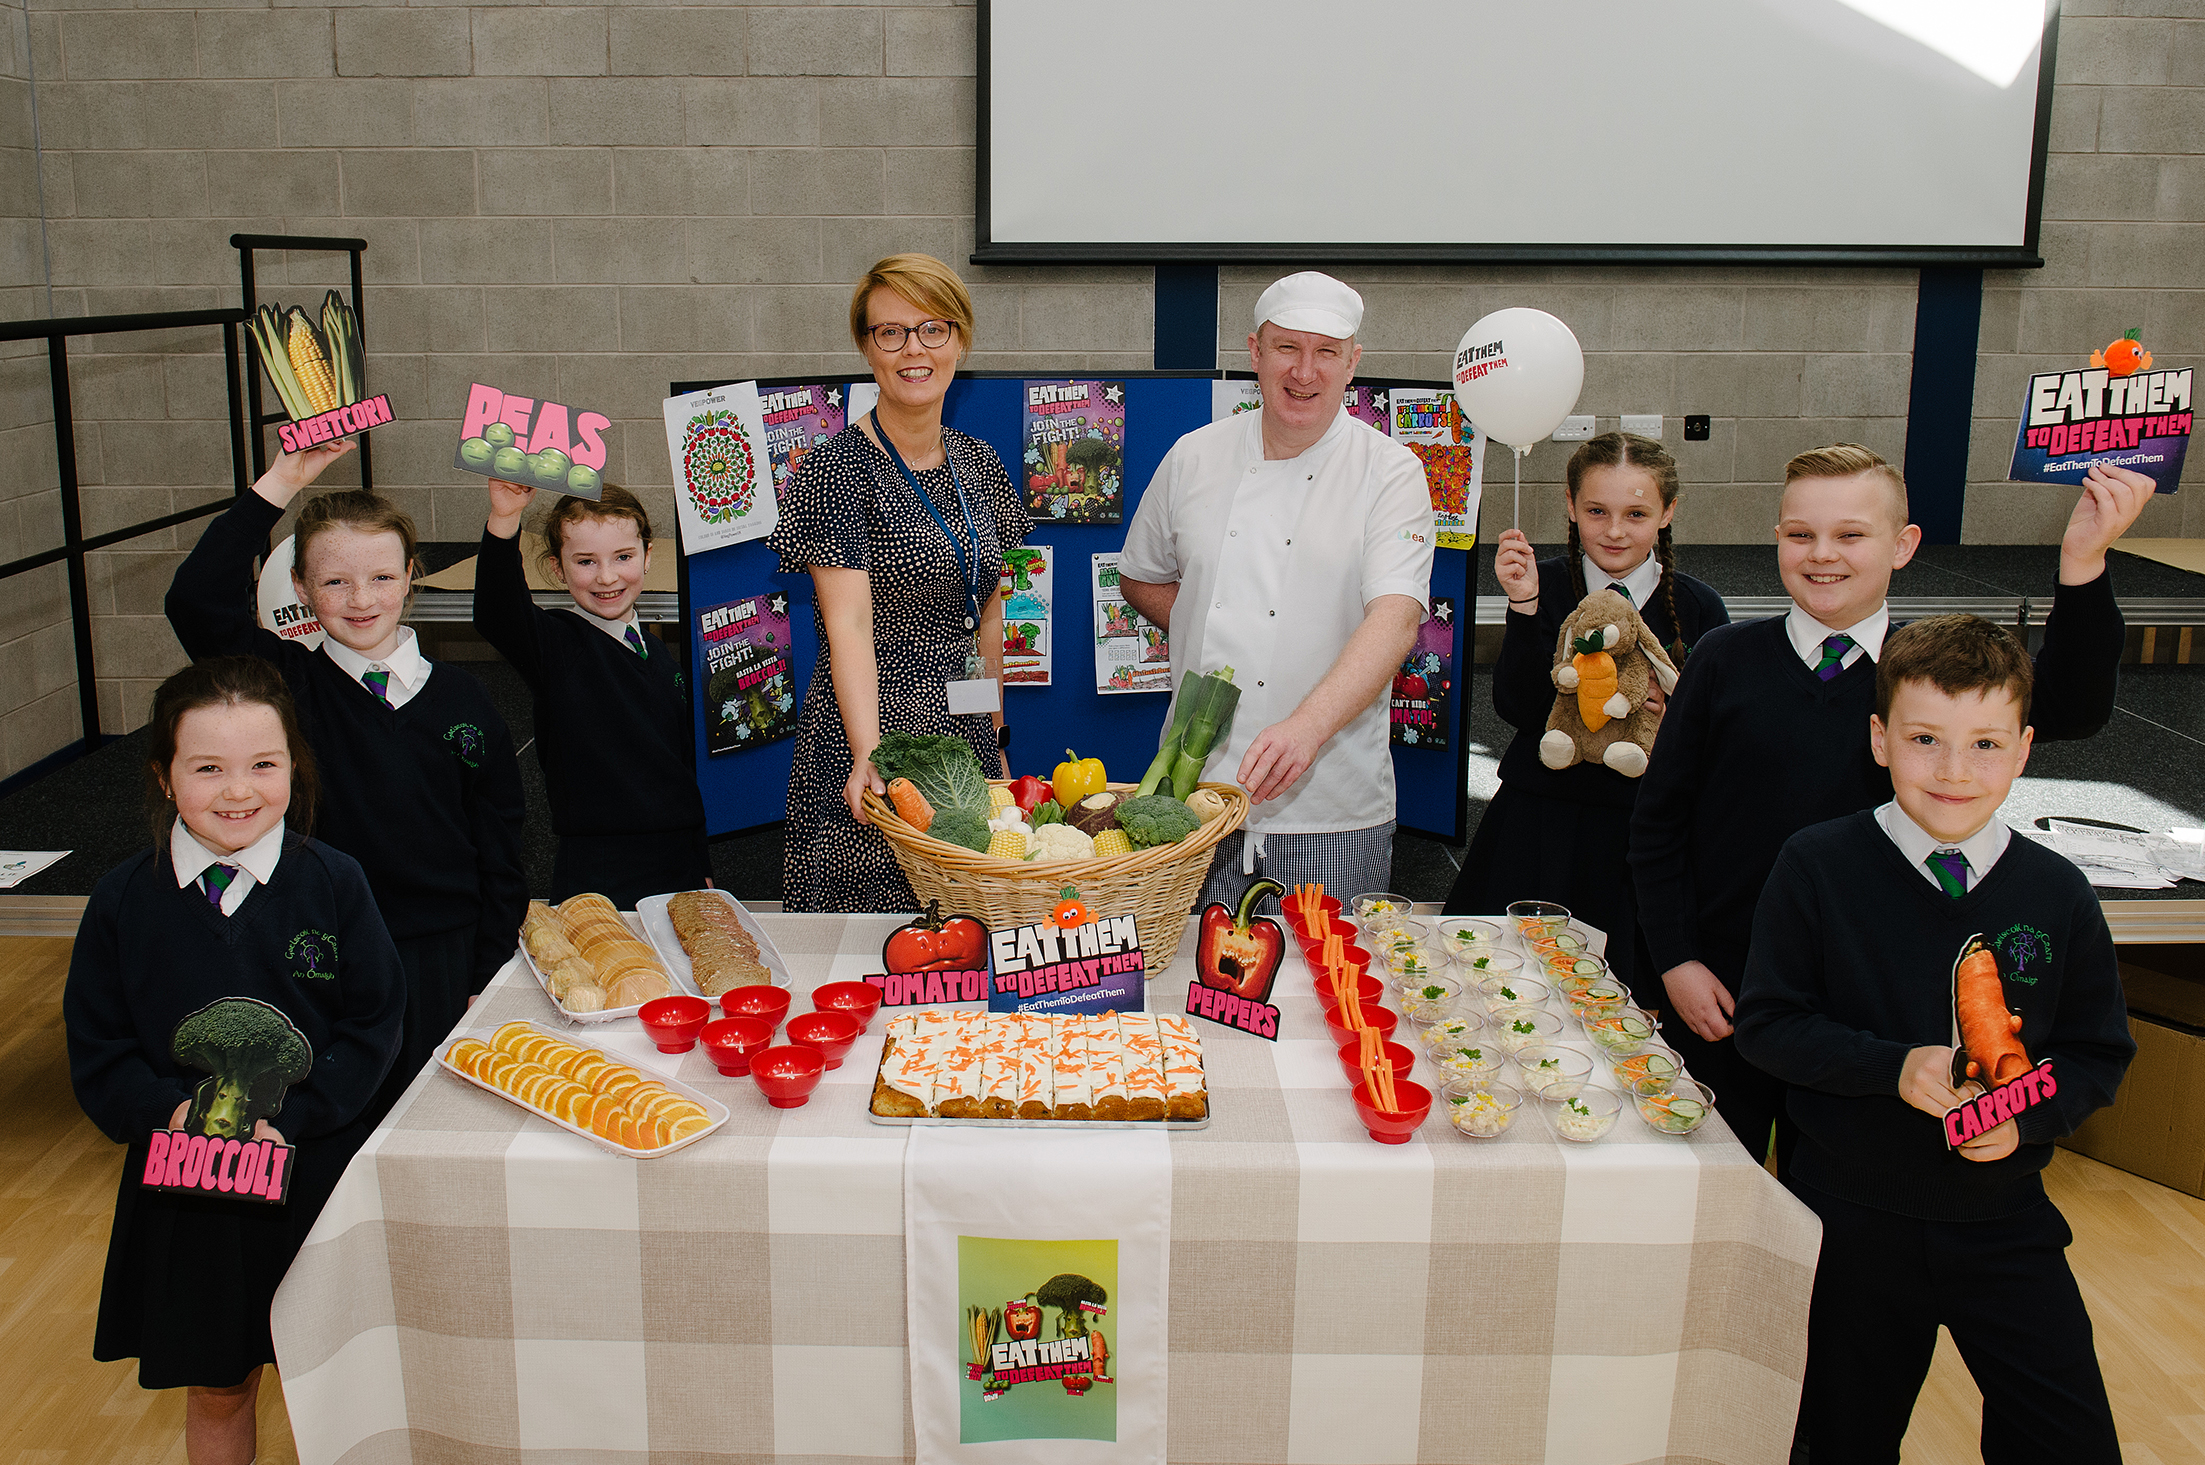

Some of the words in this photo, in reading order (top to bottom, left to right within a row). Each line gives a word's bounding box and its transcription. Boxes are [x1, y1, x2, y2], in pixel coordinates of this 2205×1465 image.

[1457, 346, 1475, 369] EAT
[1475, 340, 1503, 360] THEM
[1461, 363, 1488, 384] DEFEAT
[1489, 358, 1508, 370] THEM
[759, 391, 784, 415] EAT
[785, 389, 812, 409] THEM
[1029, 385, 1057, 405] EAT
[1058, 384, 1089, 402] THEM
[2029, 369, 2109, 426] EAT
[2109, 370, 2193, 415] THEM
[768, 409, 799, 426] DEFEAT
[1029, 405, 1038, 413] TO
[1038, 401, 1072, 415] DEFEAT
[1072, 399, 1090, 409] THEM
[278, 394, 394, 454] SWEETCORN
[460, 383, 612, 471] PEAS
[1030, 418, 1060, 433] JOIN
[1060, 419, 1077, 427] THE
[1397, 412, 1452, 428] CARROTS!
[767, 427, 788, 443] OIN
[789, 426, 805, 436] THE
[767, 435, 807, 456] FIGHT!
[1032, 427, 1080, 445] FIGHT!
[2027, 427, 2051, 448] TO
[2049, 418, 2144, 455] DEFEAT
[2145, 413, 2192, 438] THEM
[2043, 453, 2164, 473] #EatThemToDefeatThem
[1412, 533, 1424, 543] ea
[272, 603, 301, 627] EAT
[299, 605, 314, 618] TH
[701, 606, 729, 634] EAT
[728, 600, 757, 623] THEM
[279, 629, 287, 637] TO
[287, 620, 322, 639] DEFEAT
[703, 632, 712, 641] TO
[712, 621, 744, 643] DEFEAT
[744, 615, 760, 629] THEM
[707, 642, 734, 661] JOIN
[734, 638, 750, 650] THE
[709, 646, 754, 675] FIGHT!
[736, 666, 753, 679] HASTA
[753, 663, 762, 671] LA
[762, 656, 778, 668] VISTA
[738, 659, 787, 691] BROCCOLI!
[1391, 699, 1410, 708] CAN'T
[1390, 708, 1432, 725] OMATO!
[2023, 924, 2034, 934] na
[991, 923, 1061, 975] EAT
[1061, 915, 1139, 959] THEM
[995, 974, 1017, 993] TO
[1017, 959, 1100, 998] DEFEAT
[1101, 951, 1144, 976] THEM
[1017, 988, 1125, 1013] #EatThemToDefeatThem
[1188, 982, 1279, 1039] PEPPERS
[1945, 1063, 2058, 1147] CARROTS
[143, 1131, 289, 1200] BROCCOLI
[992, 1339, 1038, 1371] EAT
[1038, 1336, 1089, 1364] THEM
[994, 1371, 1008, 1381] TO
[1009, 1364, 1063, 1384] DEFEAT
[1064, 1360, 1092, 1374] THEM
